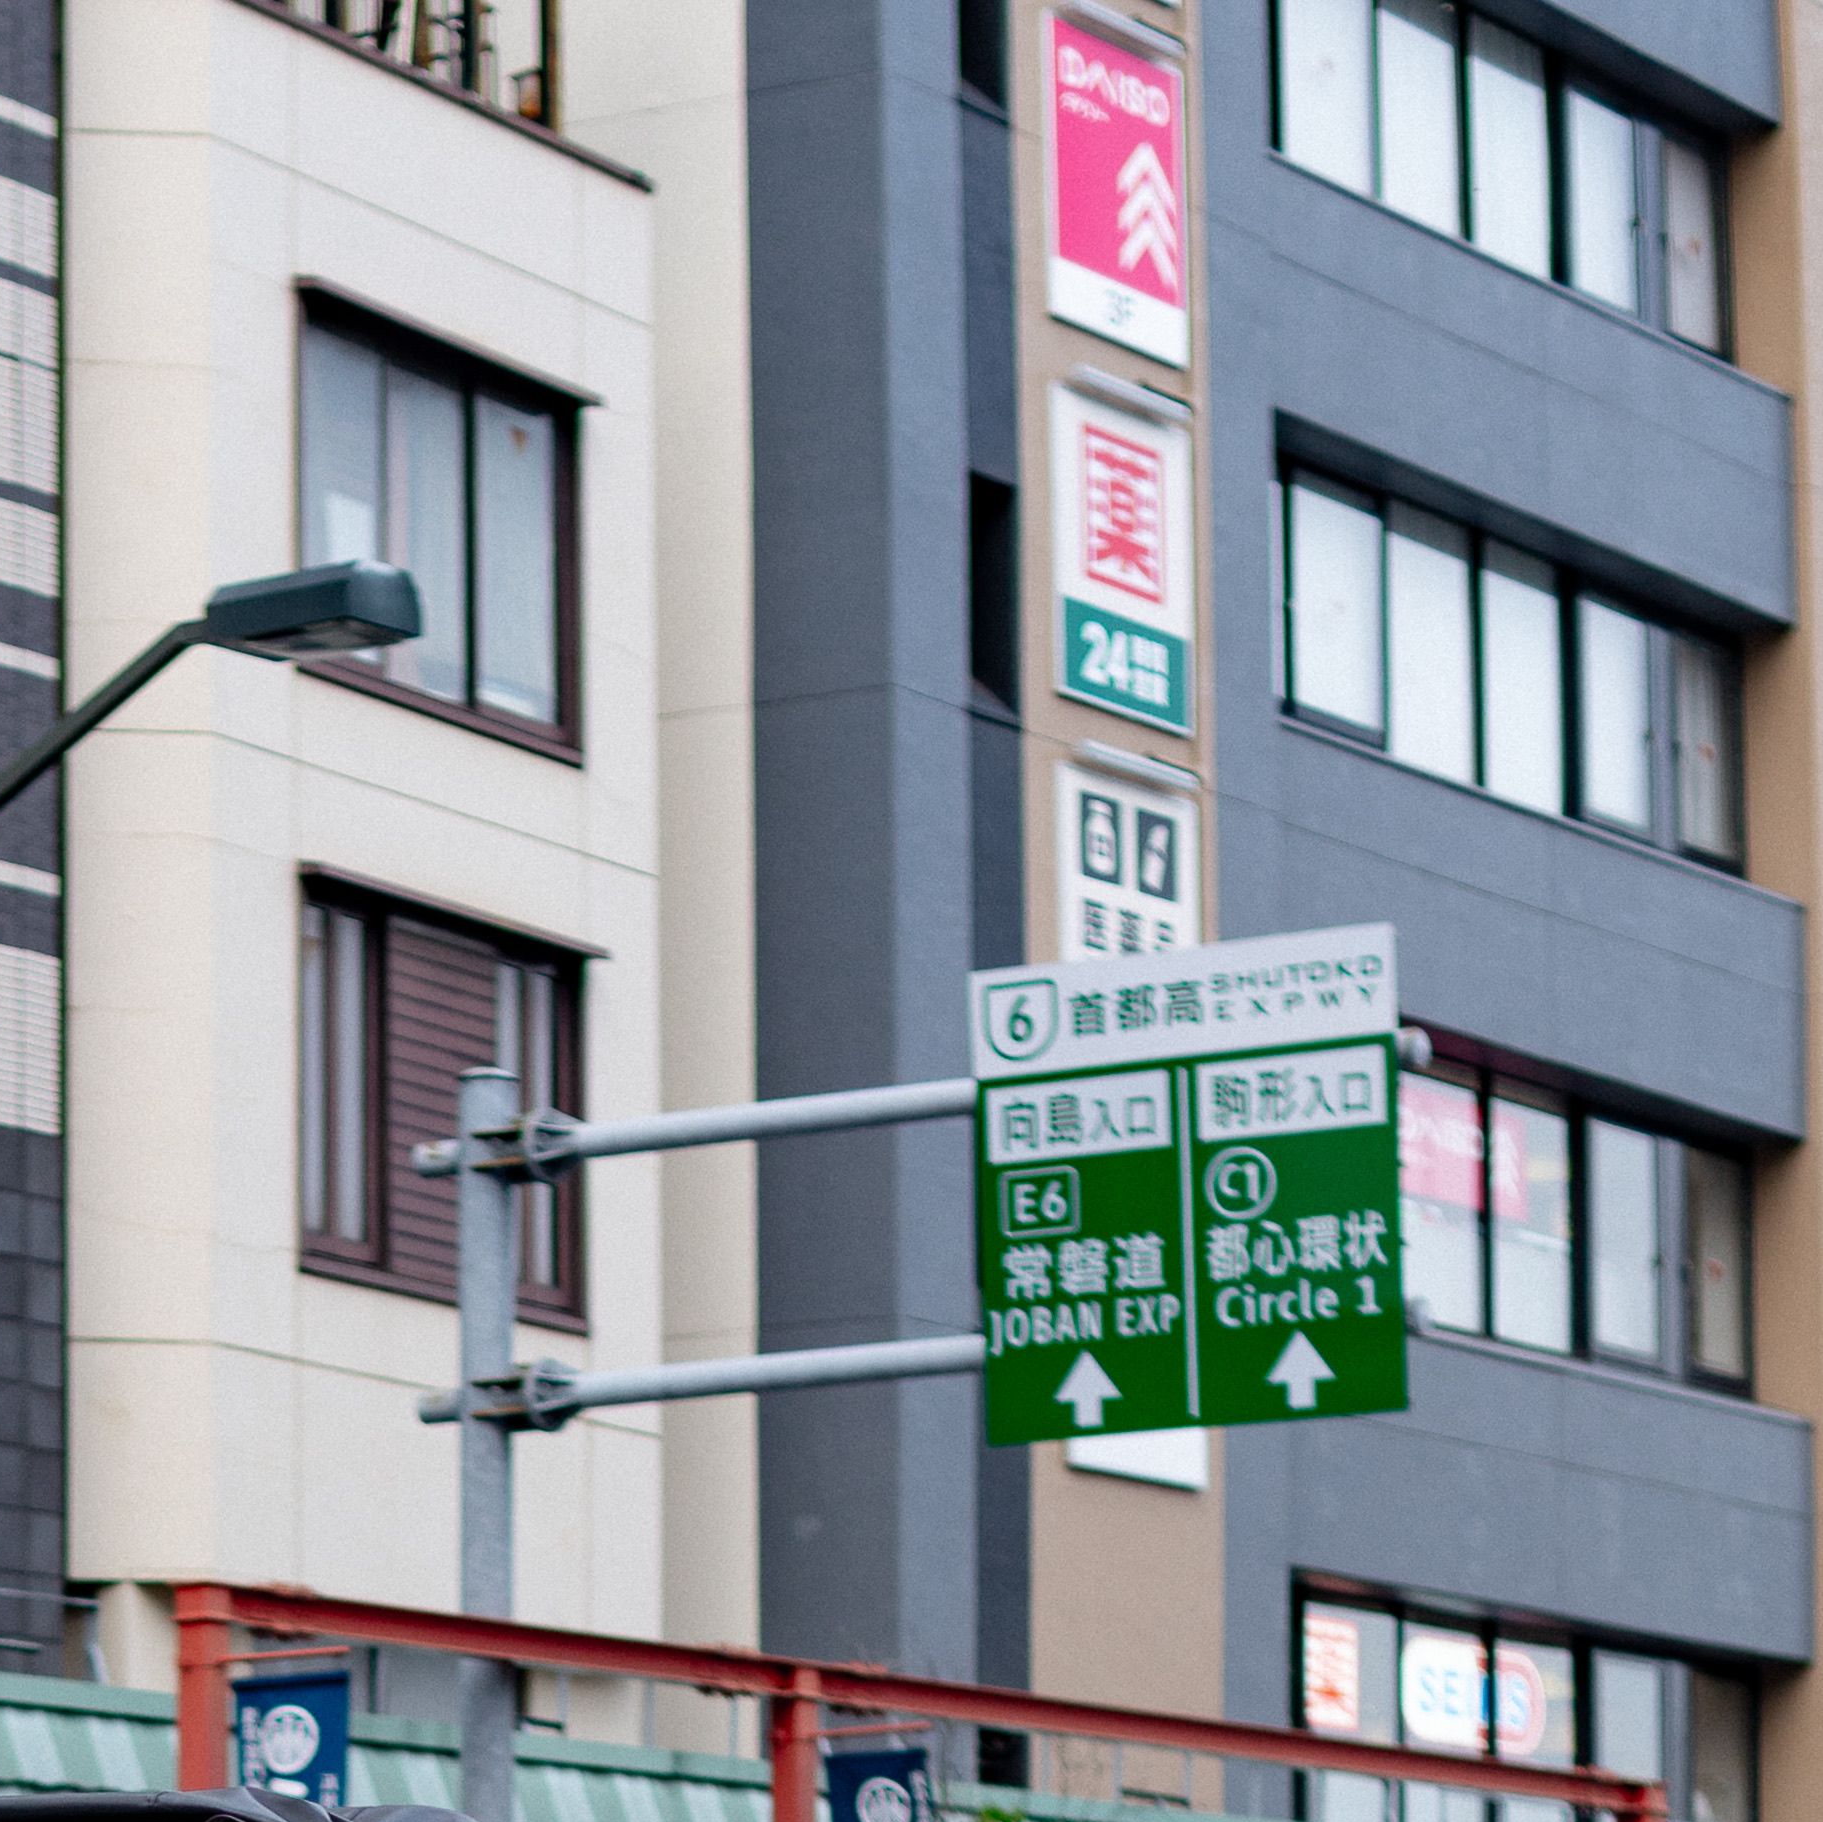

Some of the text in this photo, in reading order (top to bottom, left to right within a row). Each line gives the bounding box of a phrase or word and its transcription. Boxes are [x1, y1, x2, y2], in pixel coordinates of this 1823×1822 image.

[1209, 954, 1382, 993] SHUTOKO
[1008, 993, 1035, 1042] 6
[1069, 980, 1203, 1036] 首都高
[1002, 1094, 1156, 1151] 向島入口
[1211, 1068, 1371, 1127] 駒形入口
[1014, 1180, 1067, 1224] E6
[1218, 1162, 1260, 1202] C1
[1206, 1209, 1388, 1282] 都心環状
[989, 1293, 1181, 1358] JOBAN EXP
[1216, 1275, 1383, 1328] Circle 1
